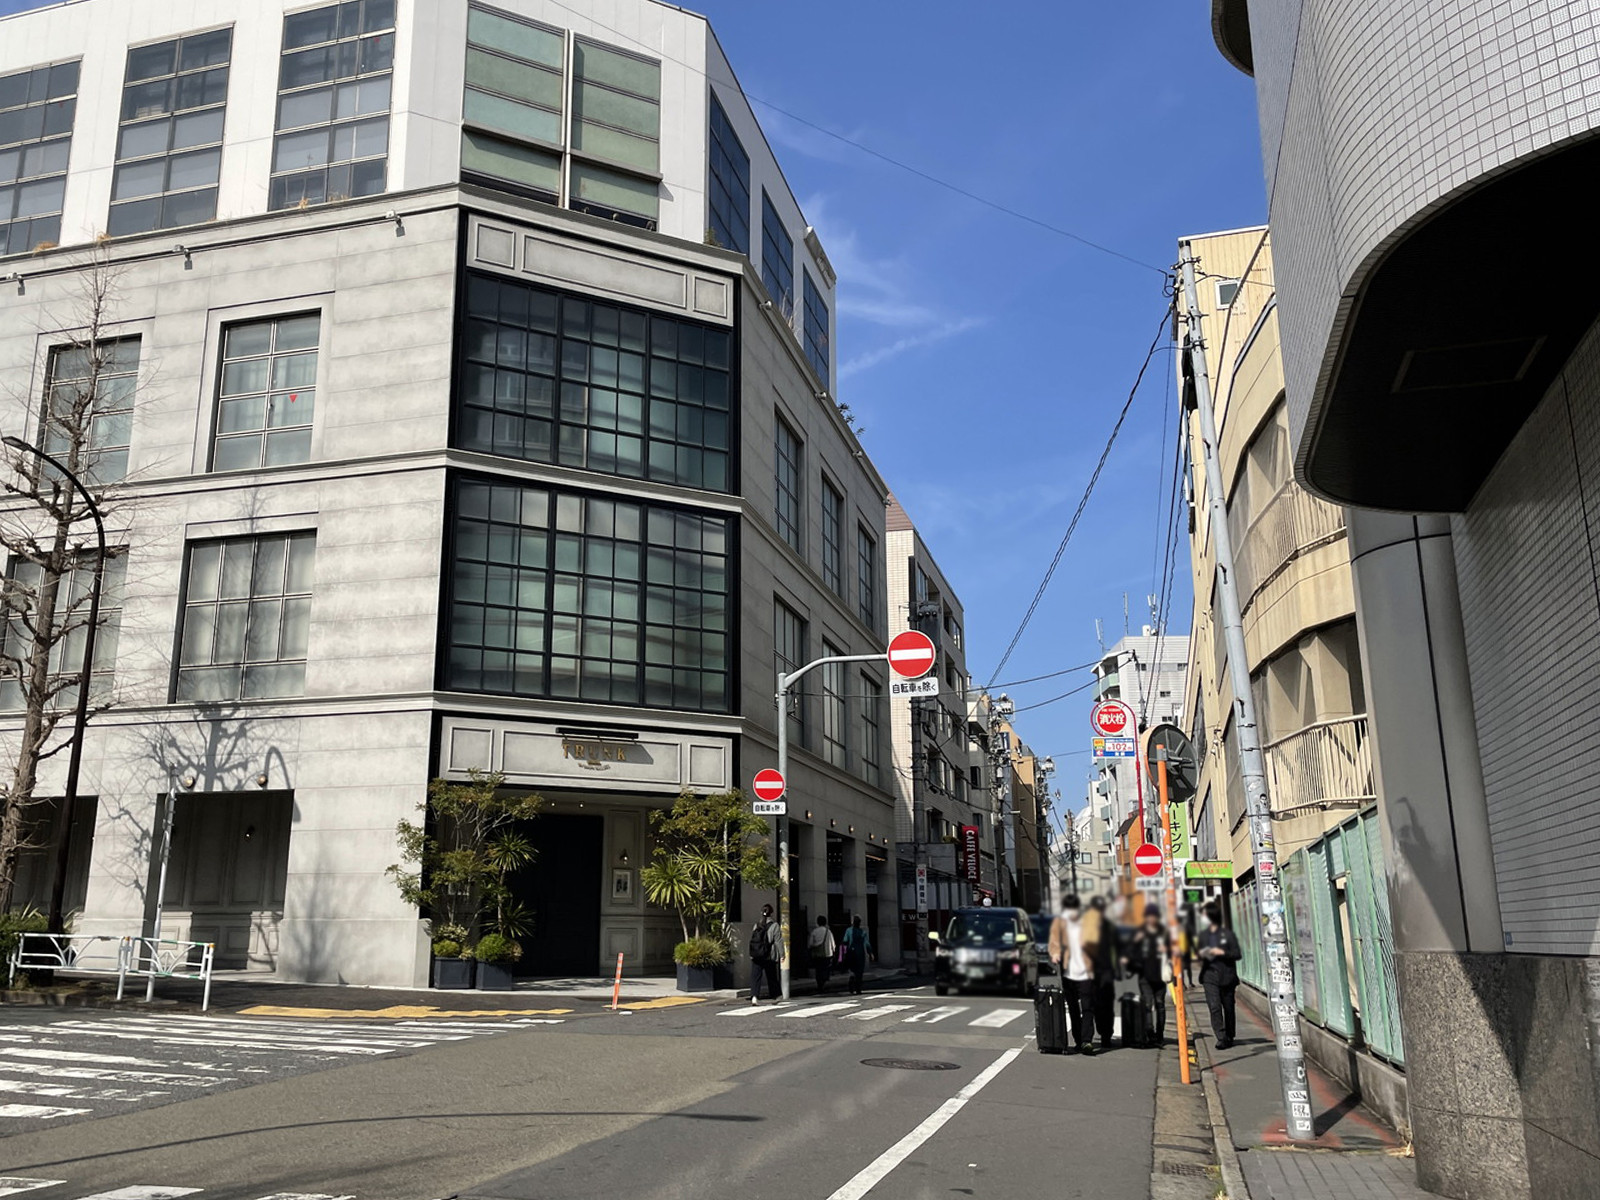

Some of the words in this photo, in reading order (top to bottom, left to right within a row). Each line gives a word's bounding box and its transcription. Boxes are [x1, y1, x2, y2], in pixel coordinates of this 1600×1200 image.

[893, 681, 936, 693] 自転車を除く
[1099, 712, 1125, 725] 消火栓
[562, 743, 626, 761] TRUNK
[966, 830, 976, 852] CAFFE
[967, 853, 977, 880] VELOCE
